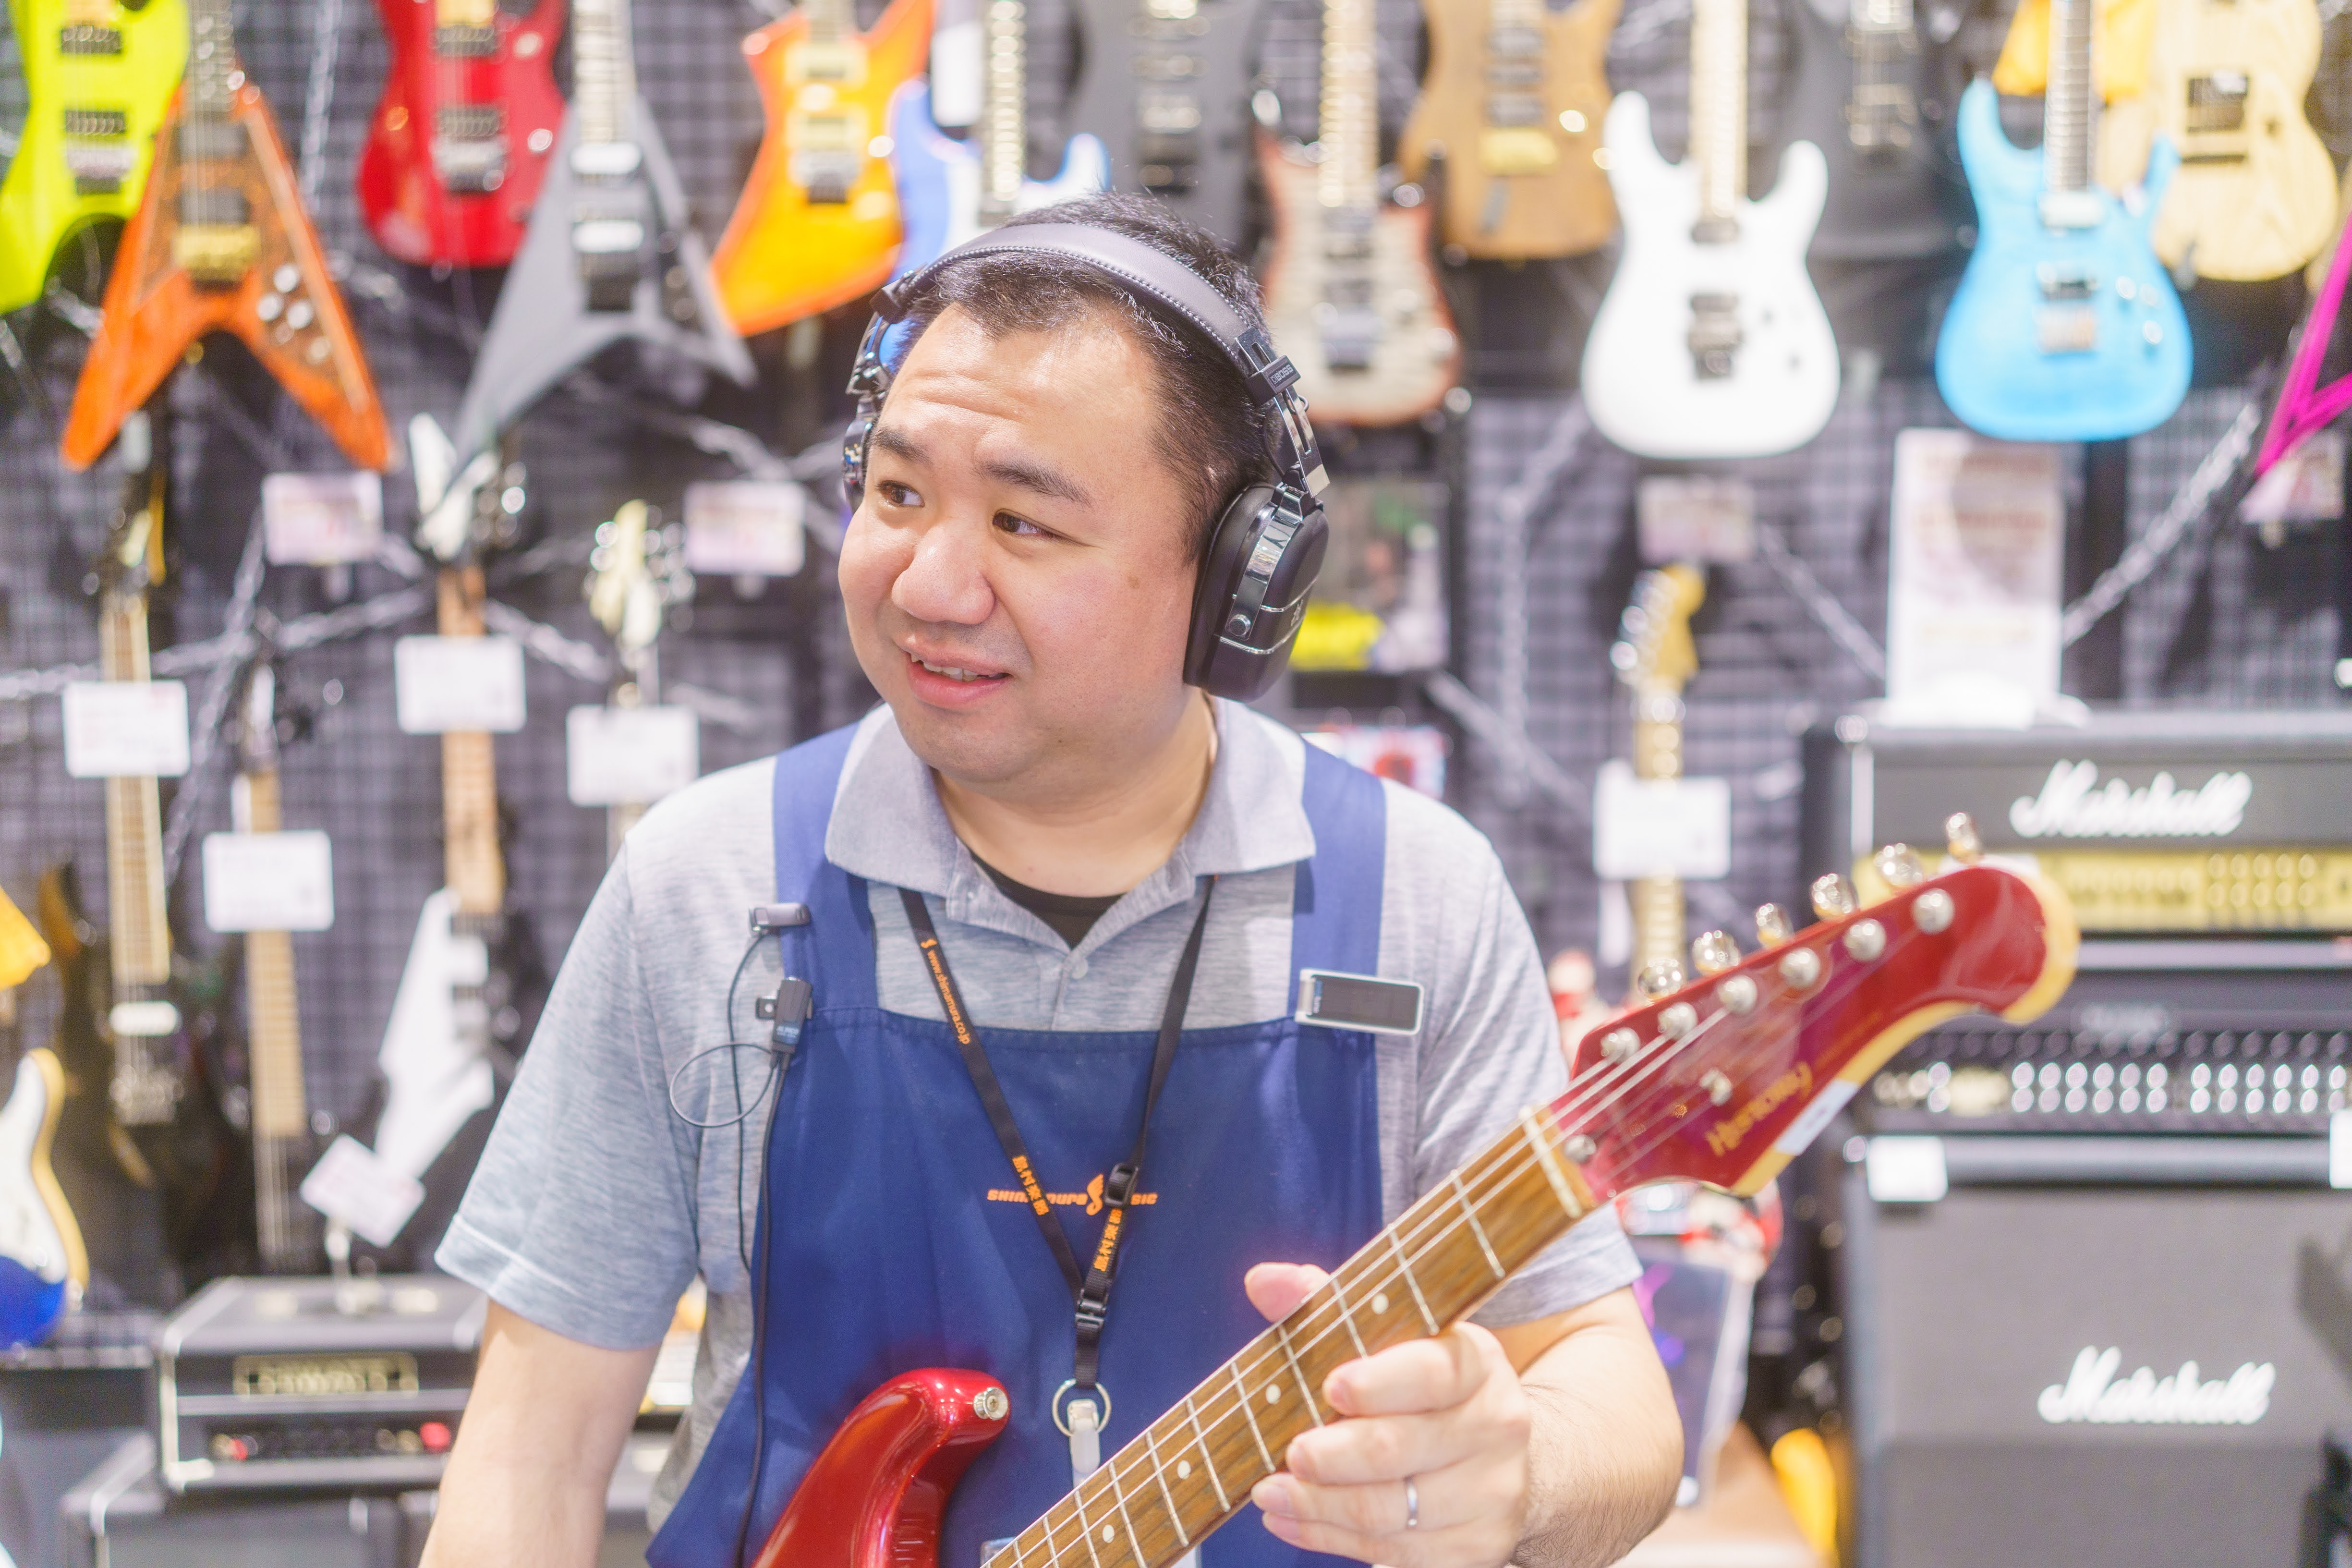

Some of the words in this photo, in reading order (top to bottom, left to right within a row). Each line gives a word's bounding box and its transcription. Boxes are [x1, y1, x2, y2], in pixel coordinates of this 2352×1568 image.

[1274, 364, 1294, 381] BOSS
[2009, 758, 2253, 838] Marshall
[927, 949, 970, 1045] www.shimamura.co.jp
[1012, 1155, 1050, 1216] 島村楽器
[2037, 1345, 2276, 1425] Marshall
